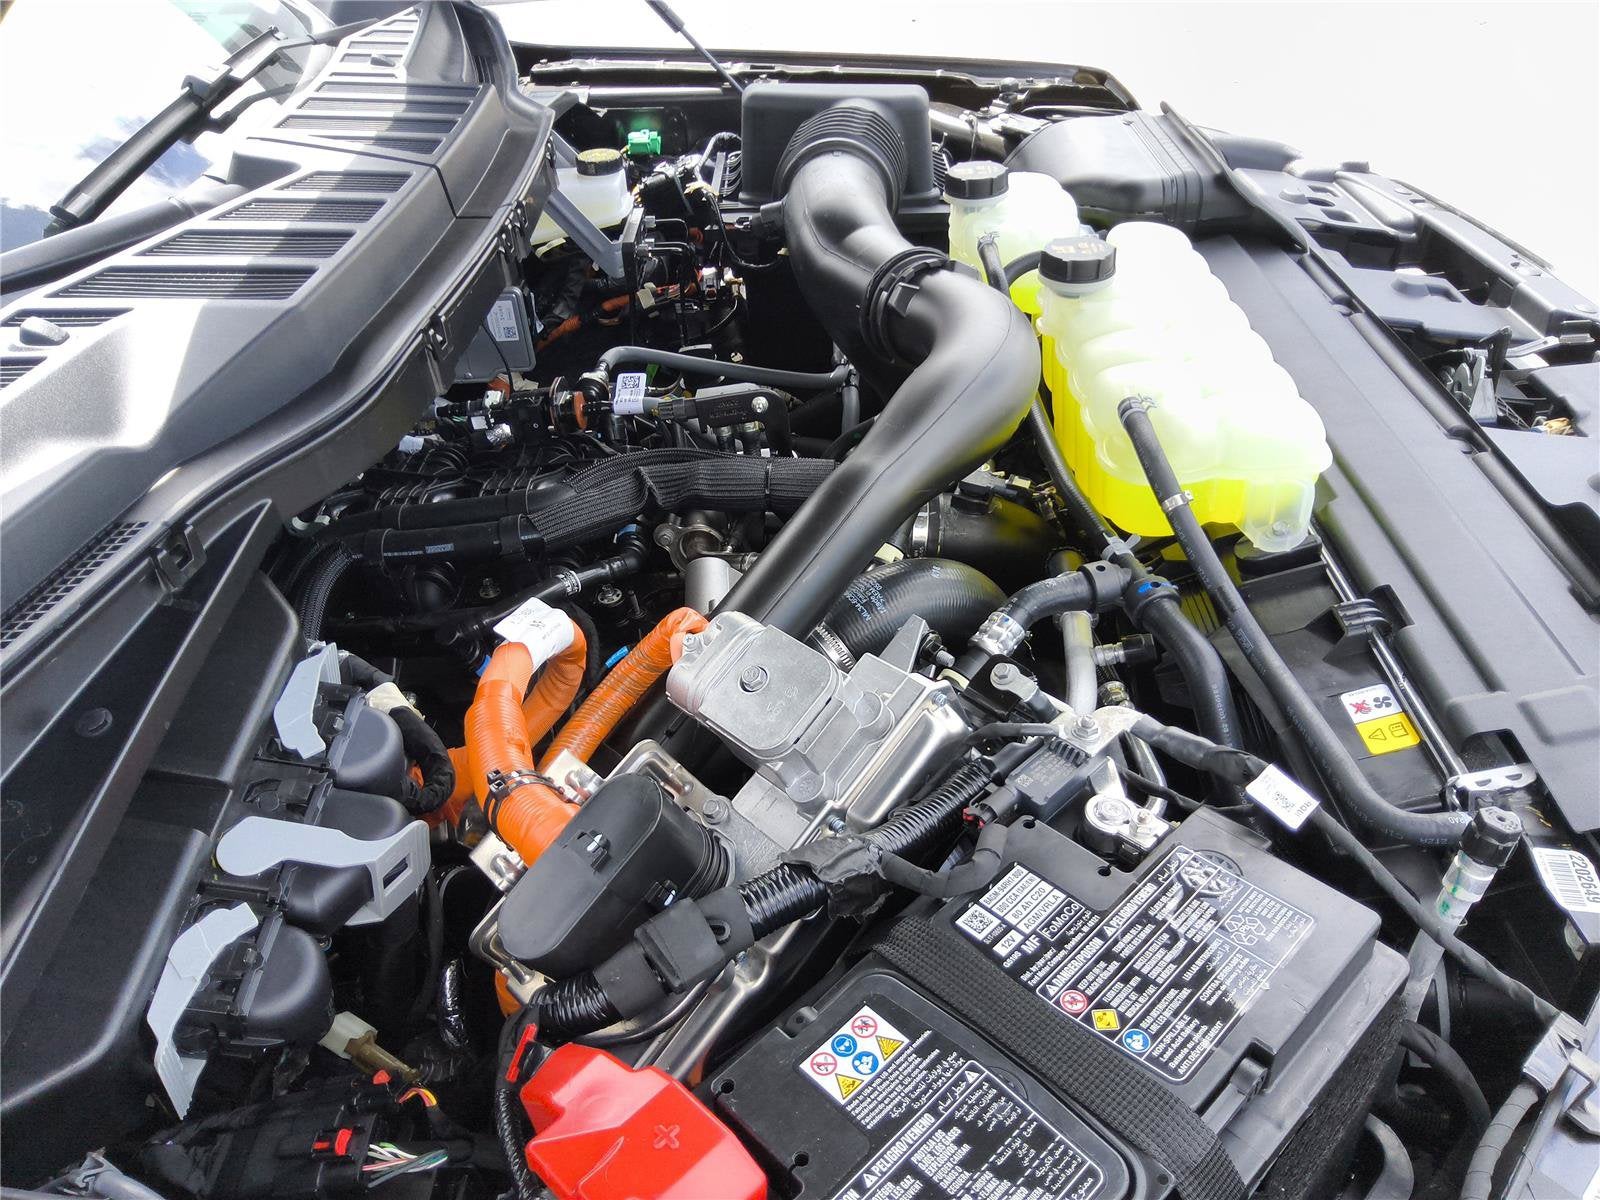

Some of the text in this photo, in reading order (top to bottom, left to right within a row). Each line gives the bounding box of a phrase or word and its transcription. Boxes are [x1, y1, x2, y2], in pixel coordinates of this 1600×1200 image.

[1569, 854, 1600, 904] 2202649
[1019, 899, 1033, 911] Ah
[1029, 886, 1047, 901] C20
[1020, 893, 1062, 929] AGM/VRLA
[1039, 901, 1082, 937] FoMoCo
[1050, 936, 1105, 987] DANGER/POISON
[1108, 881, 1158, 928] PELIGRO/VENENO
[999, 935, 1017, 950] 12V
[1020, 933, 1043, 954] MF
[1027, 974, 1040, 986] Ford
[1198, 978, 1222, 1002] CONTRA
[1149, 1013, 1192, 1056] NON-SPILLABLE
[1158, 1017, 1201, 1062] Lead Acid Battery
[1167, 1023, 1211, 1068] Batterie au plomb
[1176, 1020, 1226, 1074] ANTI DÉVERSEMENT
[931, 1142, 946, 1156] LOS
[940, 1125, 962, 1146] GASES
[1021, 1119, 1040, 1138] ممنوع
[868, 1111, 937, 1177] PELIGRO/VENENO
[908, 1128, 946, 1165] PROTEJA LOS
[923, 1142, 959, 1177] EXPLOSIVOS
[931, 1160, 955, 1183] PUEDEN
[948, 1142, 972, 1164] CAUSAR
[888, 1174, 916, 1200] LES GAZ
[898, 1179, 924, 1200] EUVENT
[937, 1167, 960, 1189] DAÑOS
[946, 1167, 972, 1196] CEGUERA.
[970, 1169, 994, 1193] CHISPAS
[978, 1176, 1000, 1199] FLAMAS
[987, 1177, 1012, 1200] IGARROS
